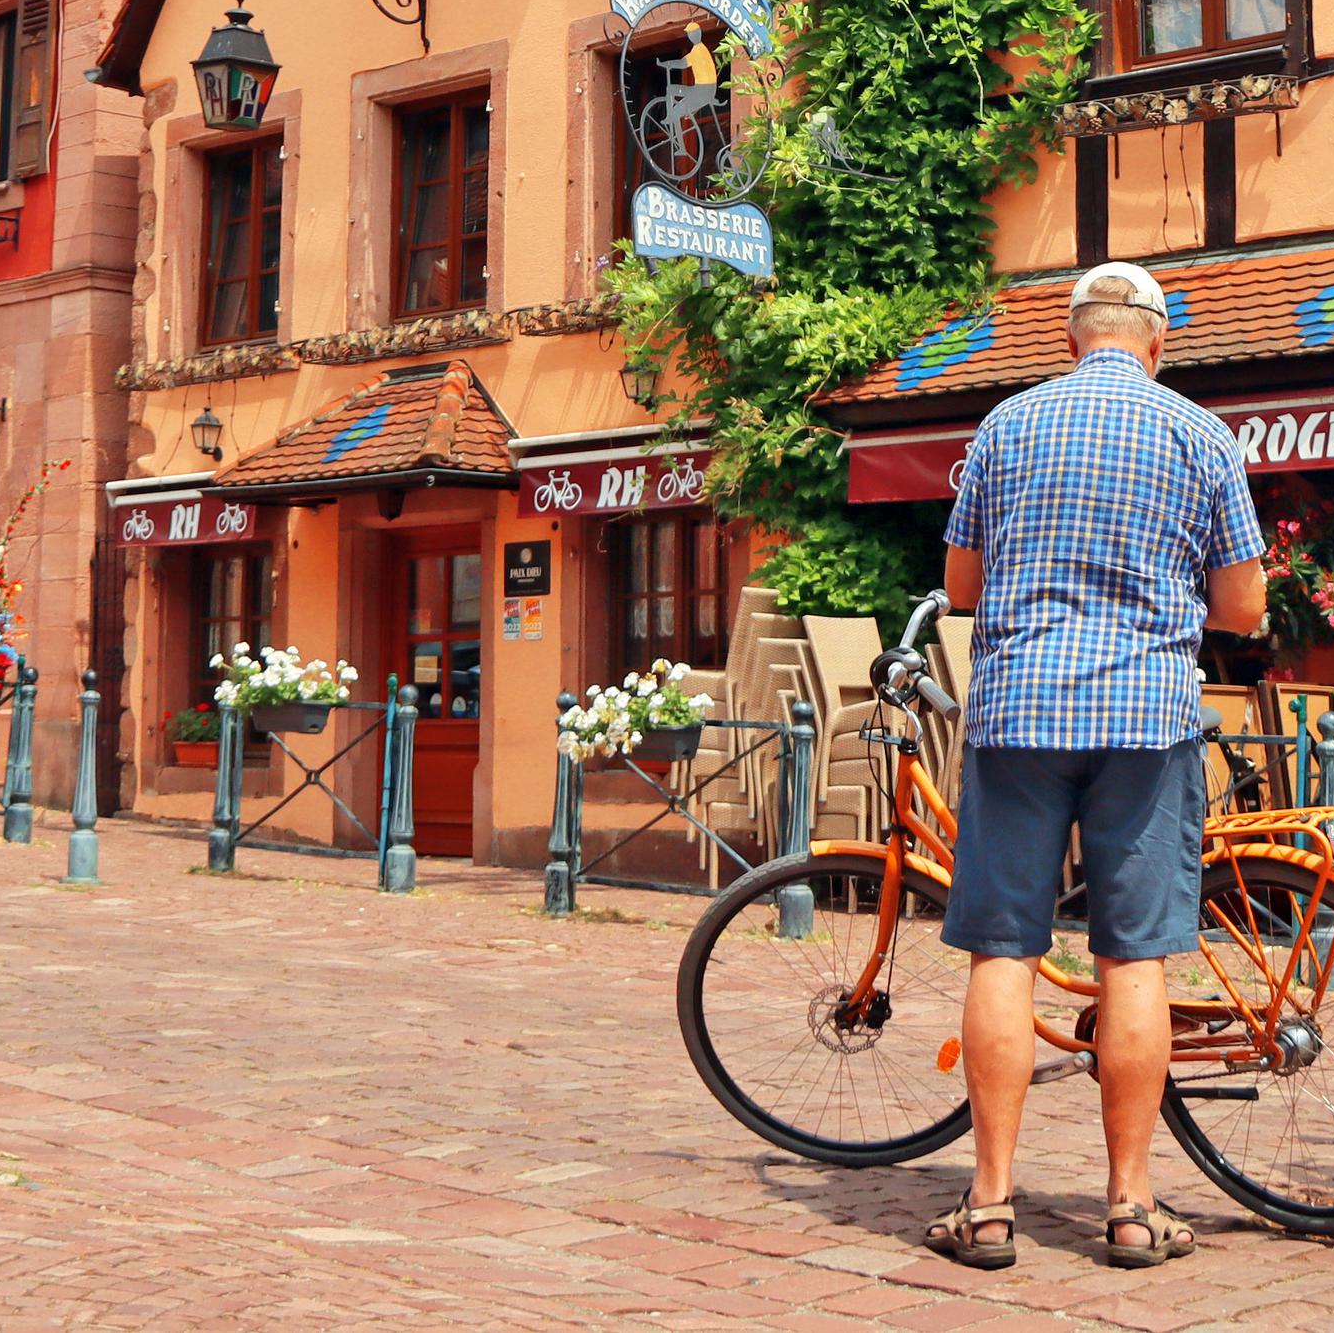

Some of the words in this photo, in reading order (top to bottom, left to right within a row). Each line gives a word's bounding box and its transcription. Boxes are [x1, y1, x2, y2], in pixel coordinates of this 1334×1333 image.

[647, 186, 764, 240] BRASSERIE
[637, 215, 768, 265] RESTAURANT
[596, 465, 646, 508] RH
[168, 502, 202, 540] RH
[509, 567, 526, 579] PAIX
